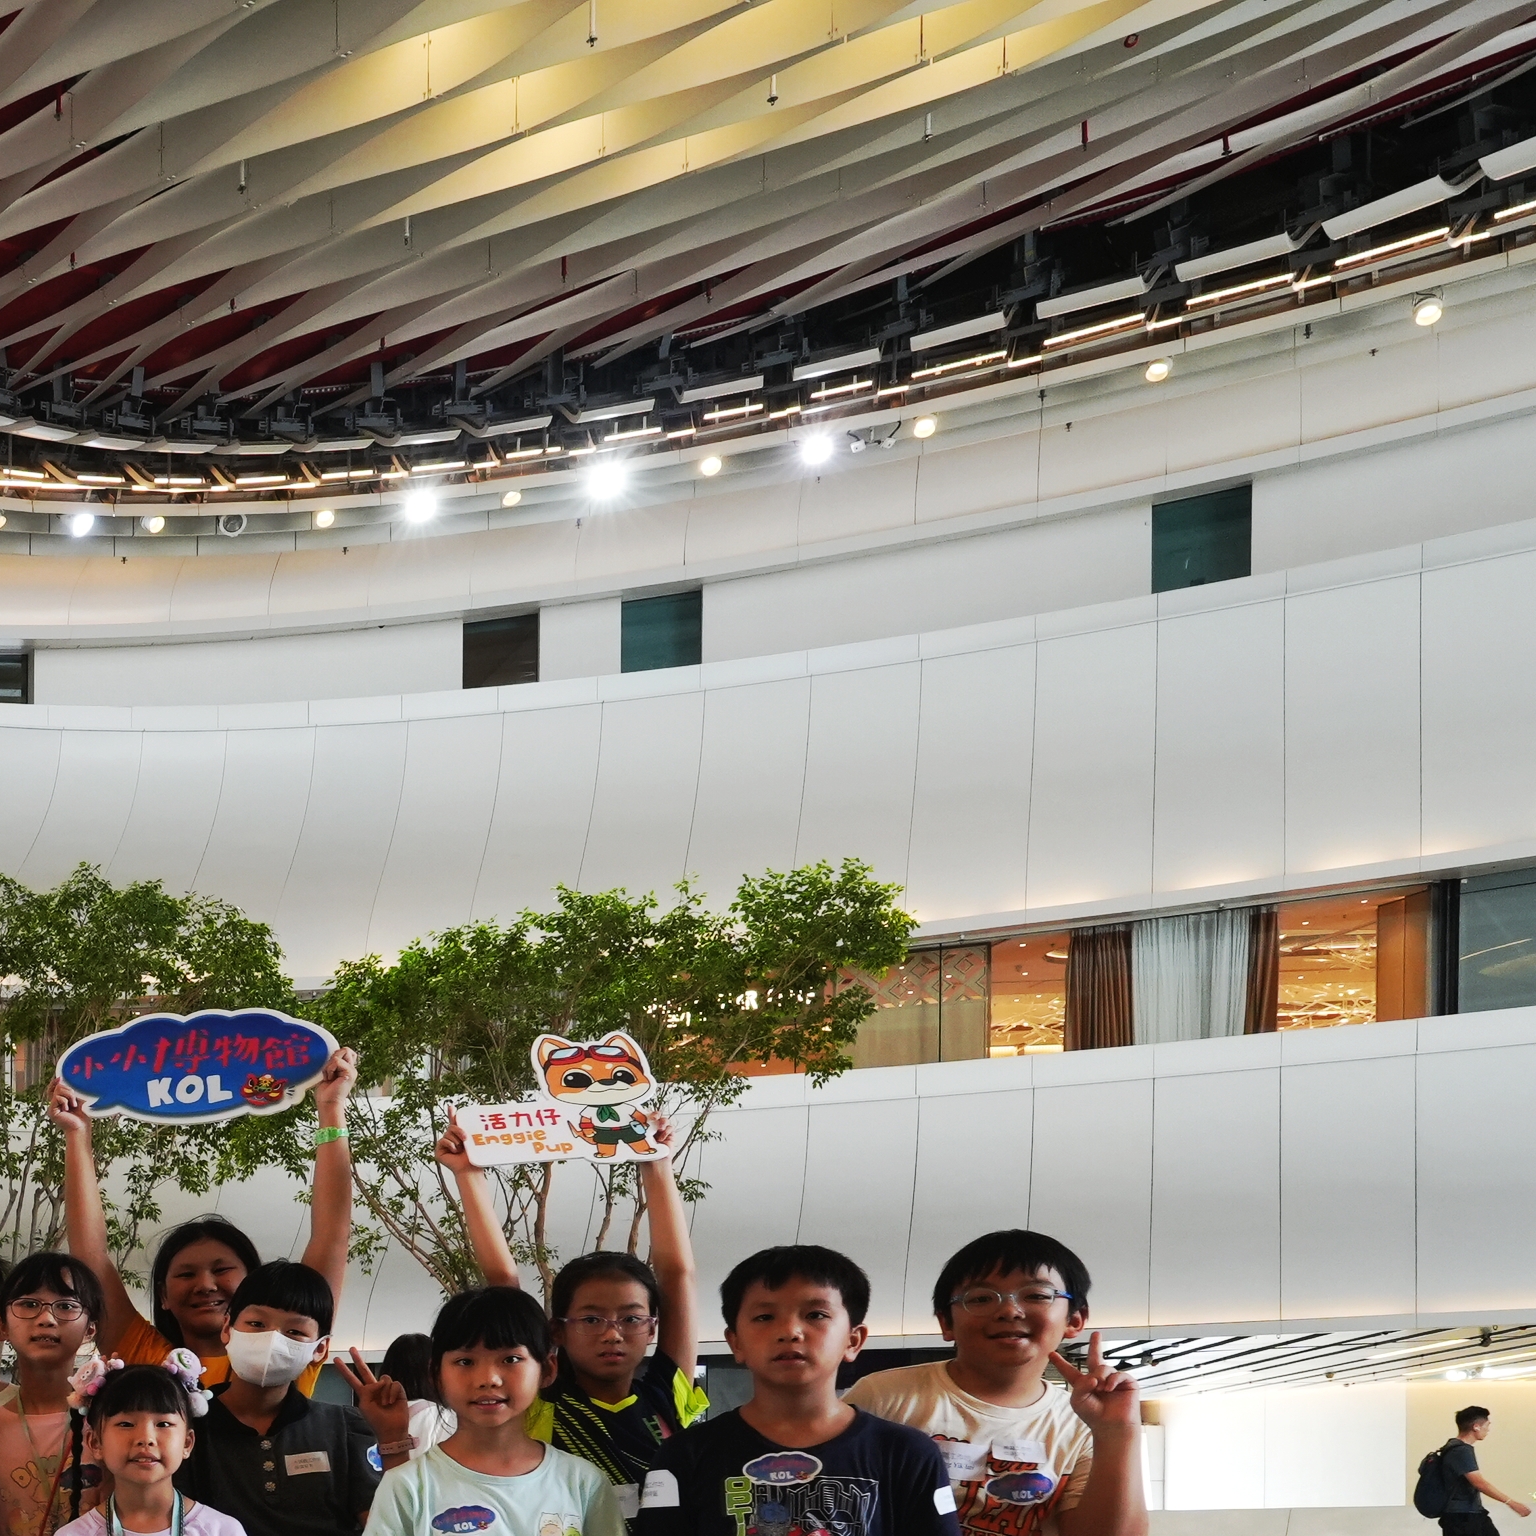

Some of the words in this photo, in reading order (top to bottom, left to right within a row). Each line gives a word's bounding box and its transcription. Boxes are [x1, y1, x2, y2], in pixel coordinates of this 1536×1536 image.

[71, 1028, 312, 1081] 小小博物館
[145, 1074, 234, 1108] KOL
[479, 1108, 561, 1131] 活力仔
[471, 1129, 547, 1147] Enggie
[769, 1471, 794, 1481] KOL
[453, 1521, 477, 1532] KOL
